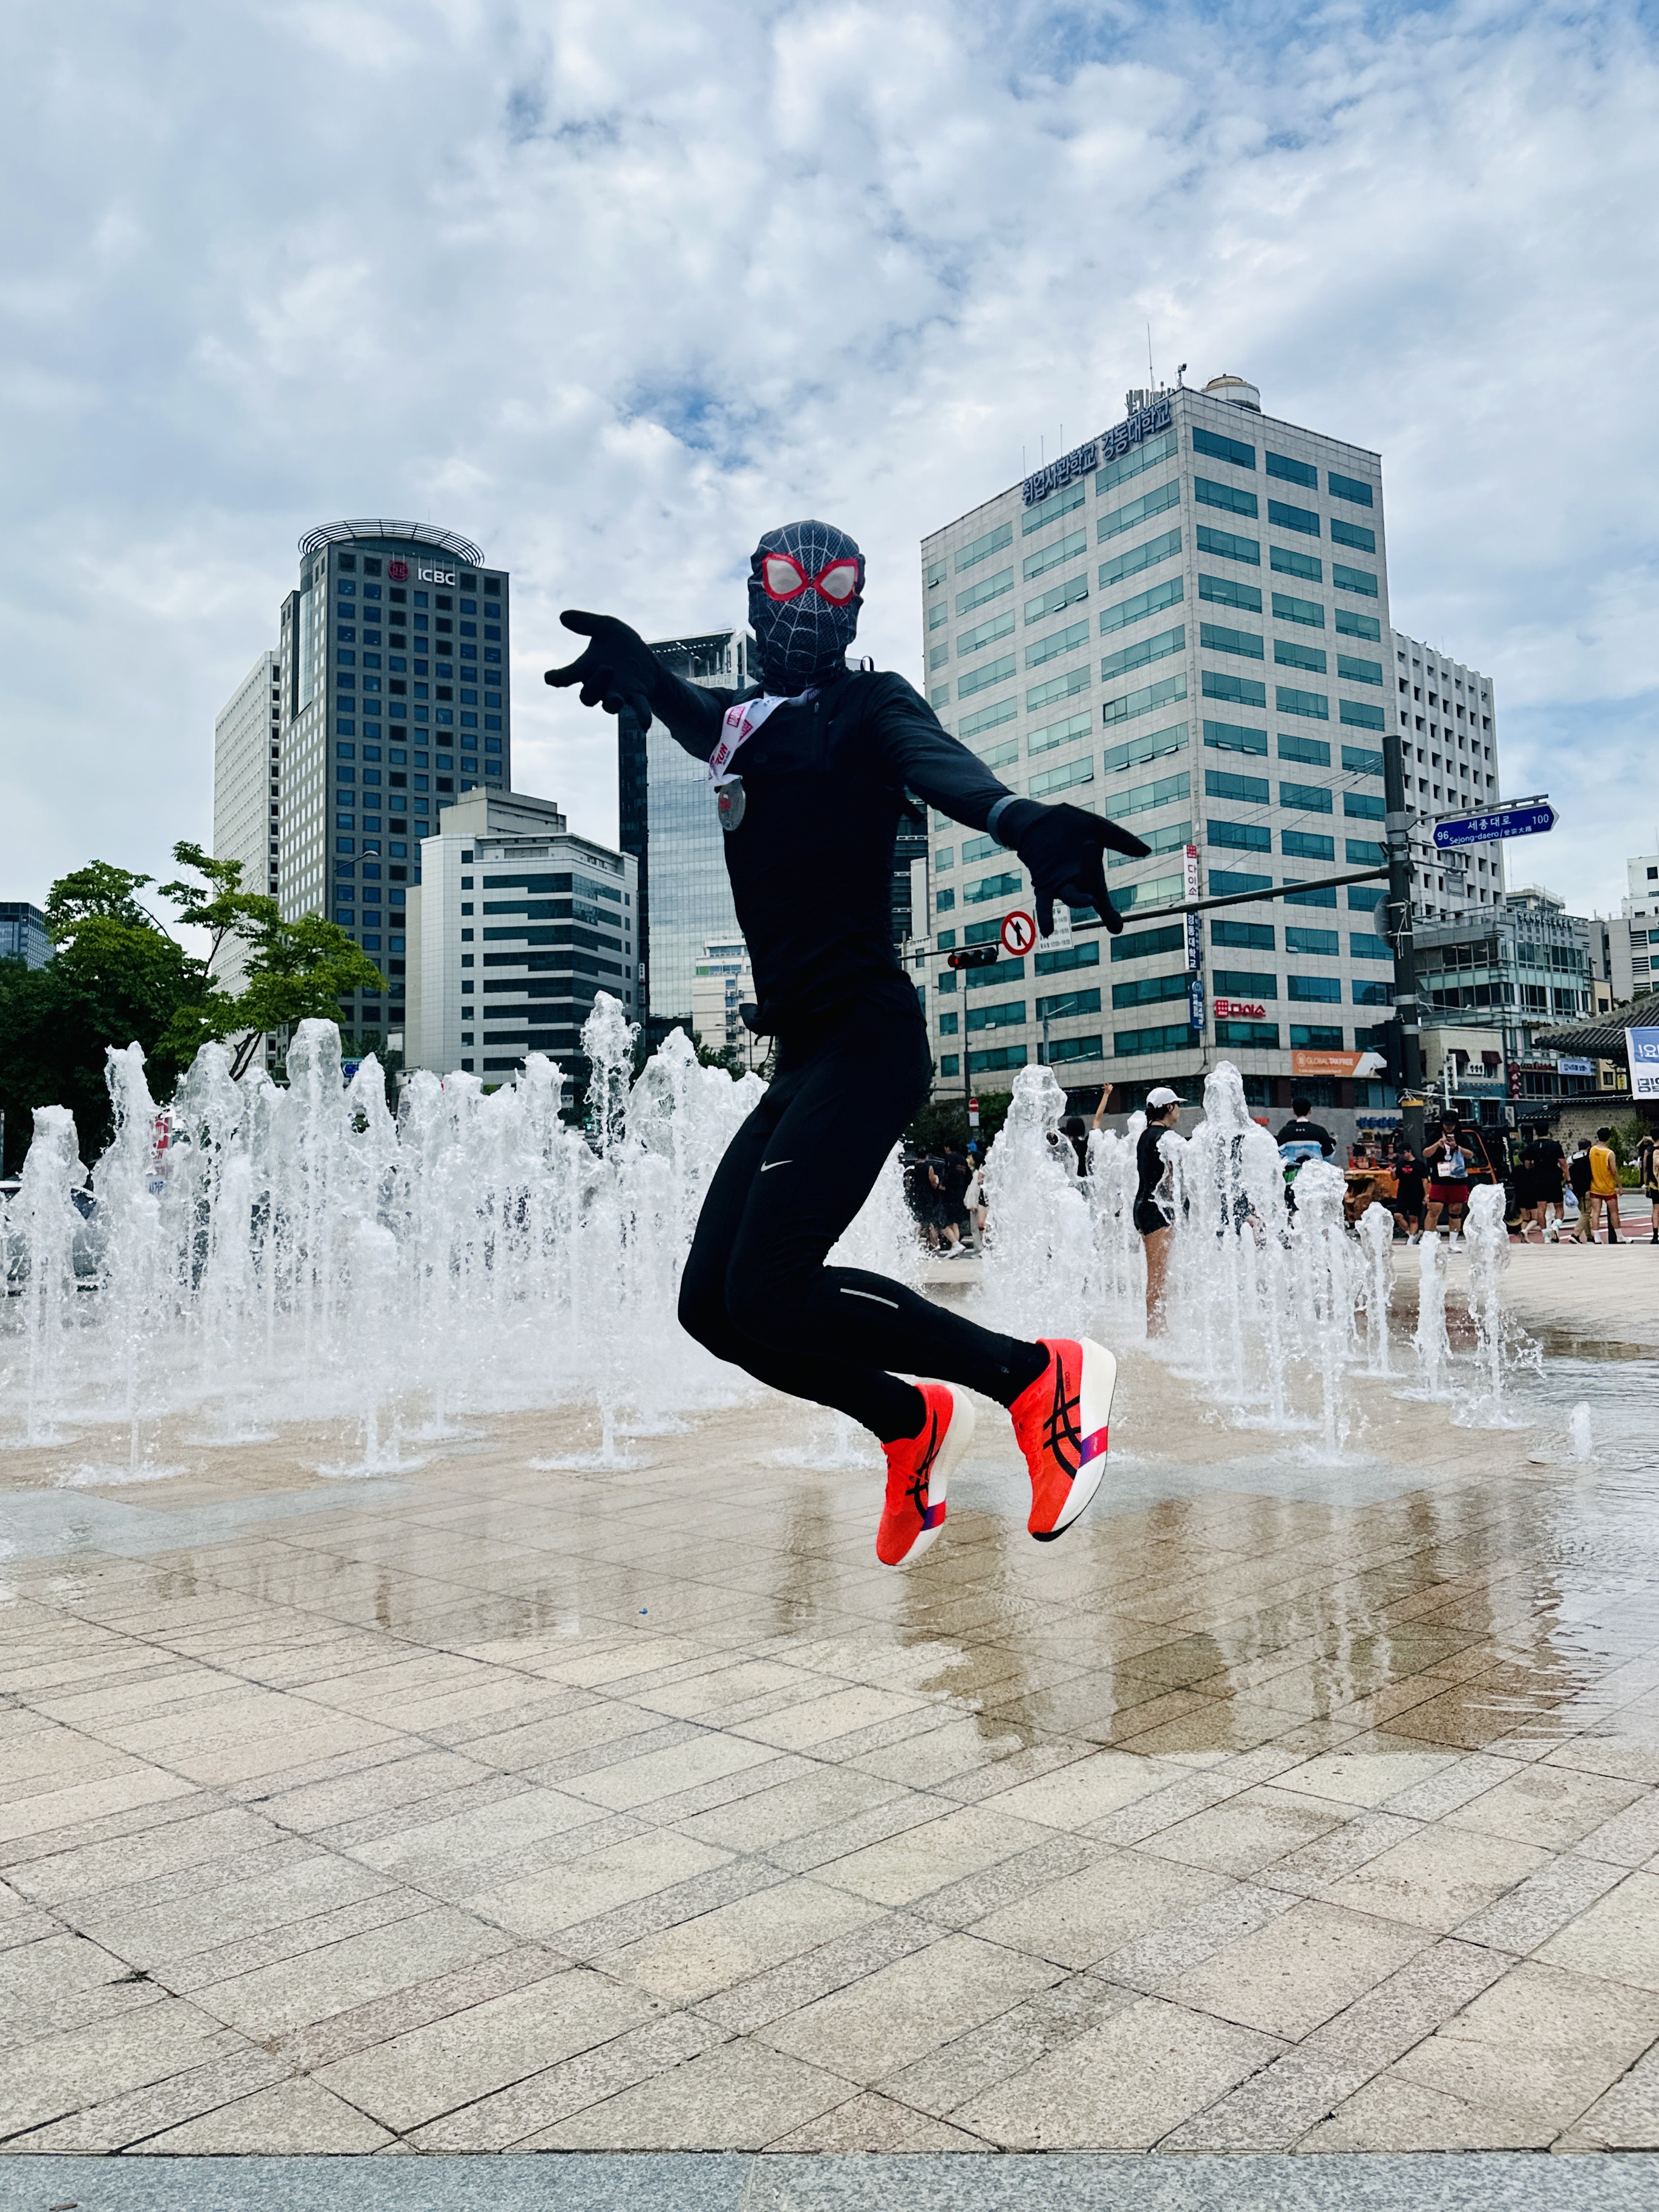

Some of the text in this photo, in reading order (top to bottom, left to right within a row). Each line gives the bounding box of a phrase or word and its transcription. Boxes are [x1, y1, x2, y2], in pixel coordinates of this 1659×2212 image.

[1021, 398, 1171, 505] 취업사관학교 경동대학교
[417, 568, 456, 586] ICBC
[715, 742, 728, 765] RUN
[1467, 815, 1511, 831] 세종대로
[1532, 814, 1549, 825] 100
[1437, 831, 1449, 841] 96
[1188, 865, 1197, 895] 다이소
[1188, 914, 1197, 968] 경동대학교
[1231, 1003, 1266, 1018] 다이소
